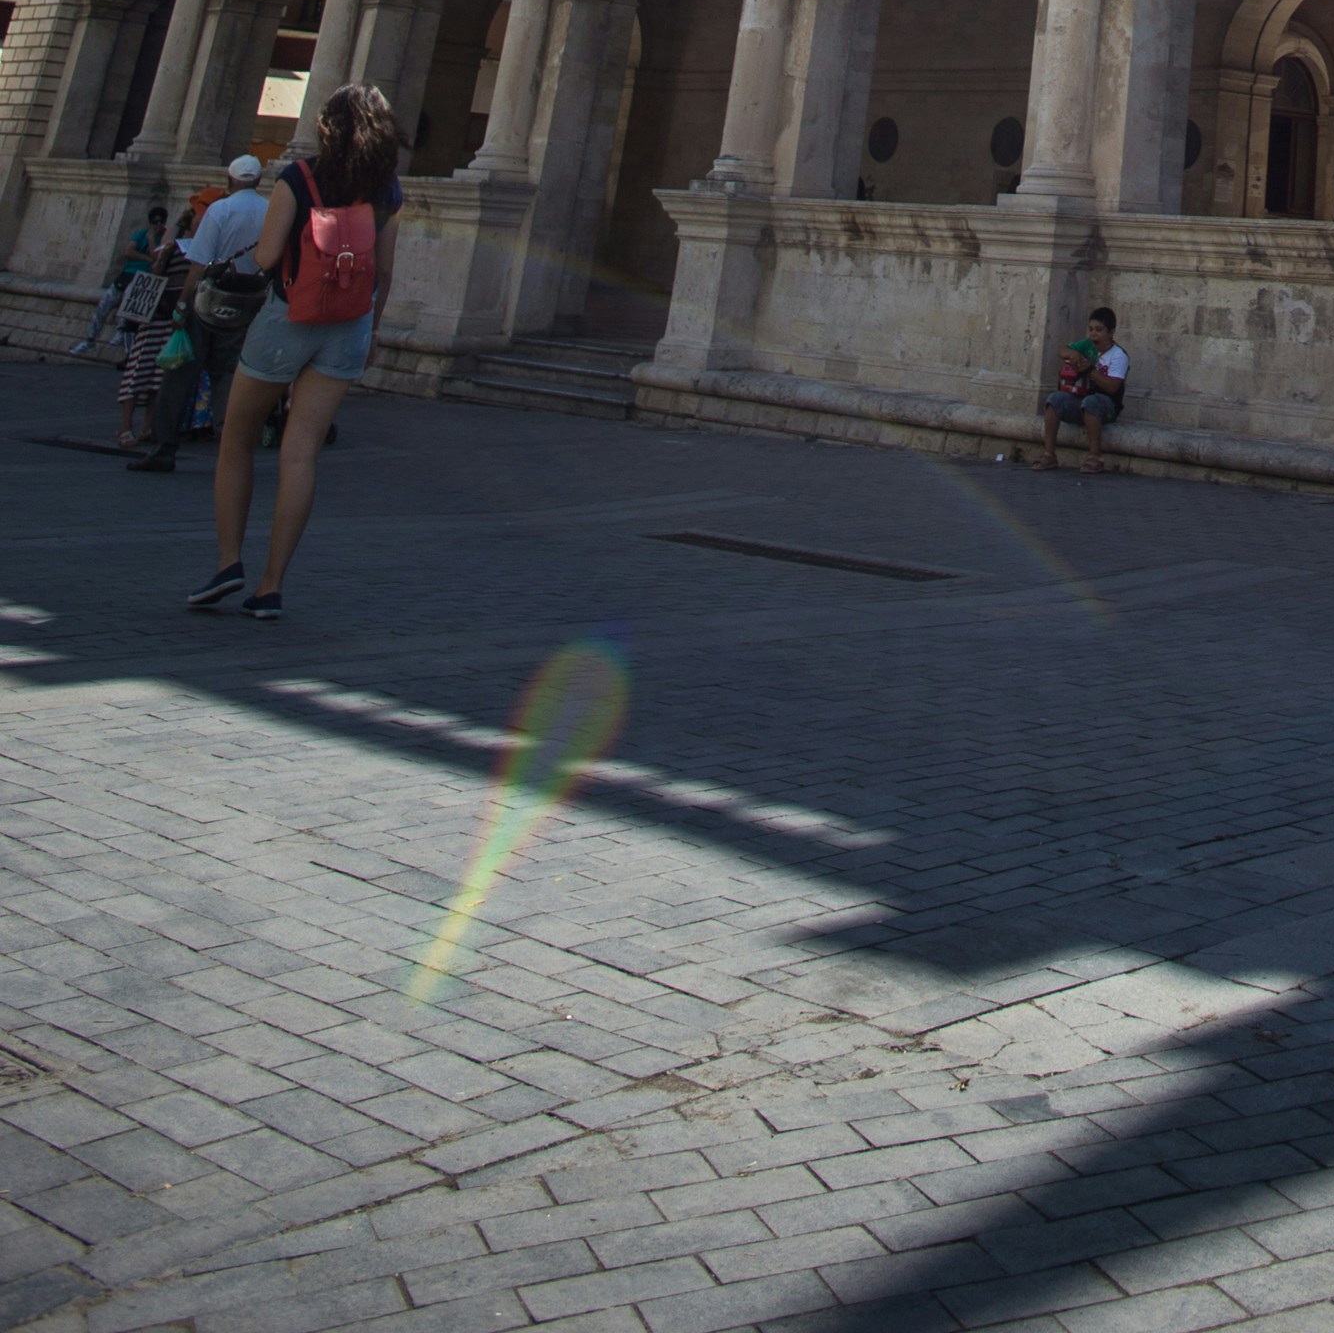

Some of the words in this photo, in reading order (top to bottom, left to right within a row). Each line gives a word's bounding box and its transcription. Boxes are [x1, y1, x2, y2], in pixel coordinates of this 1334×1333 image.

[135, 273, 152, 288] DO
[152, 278, 164, 291] IT
[130, 287, 158, 304] WITH
